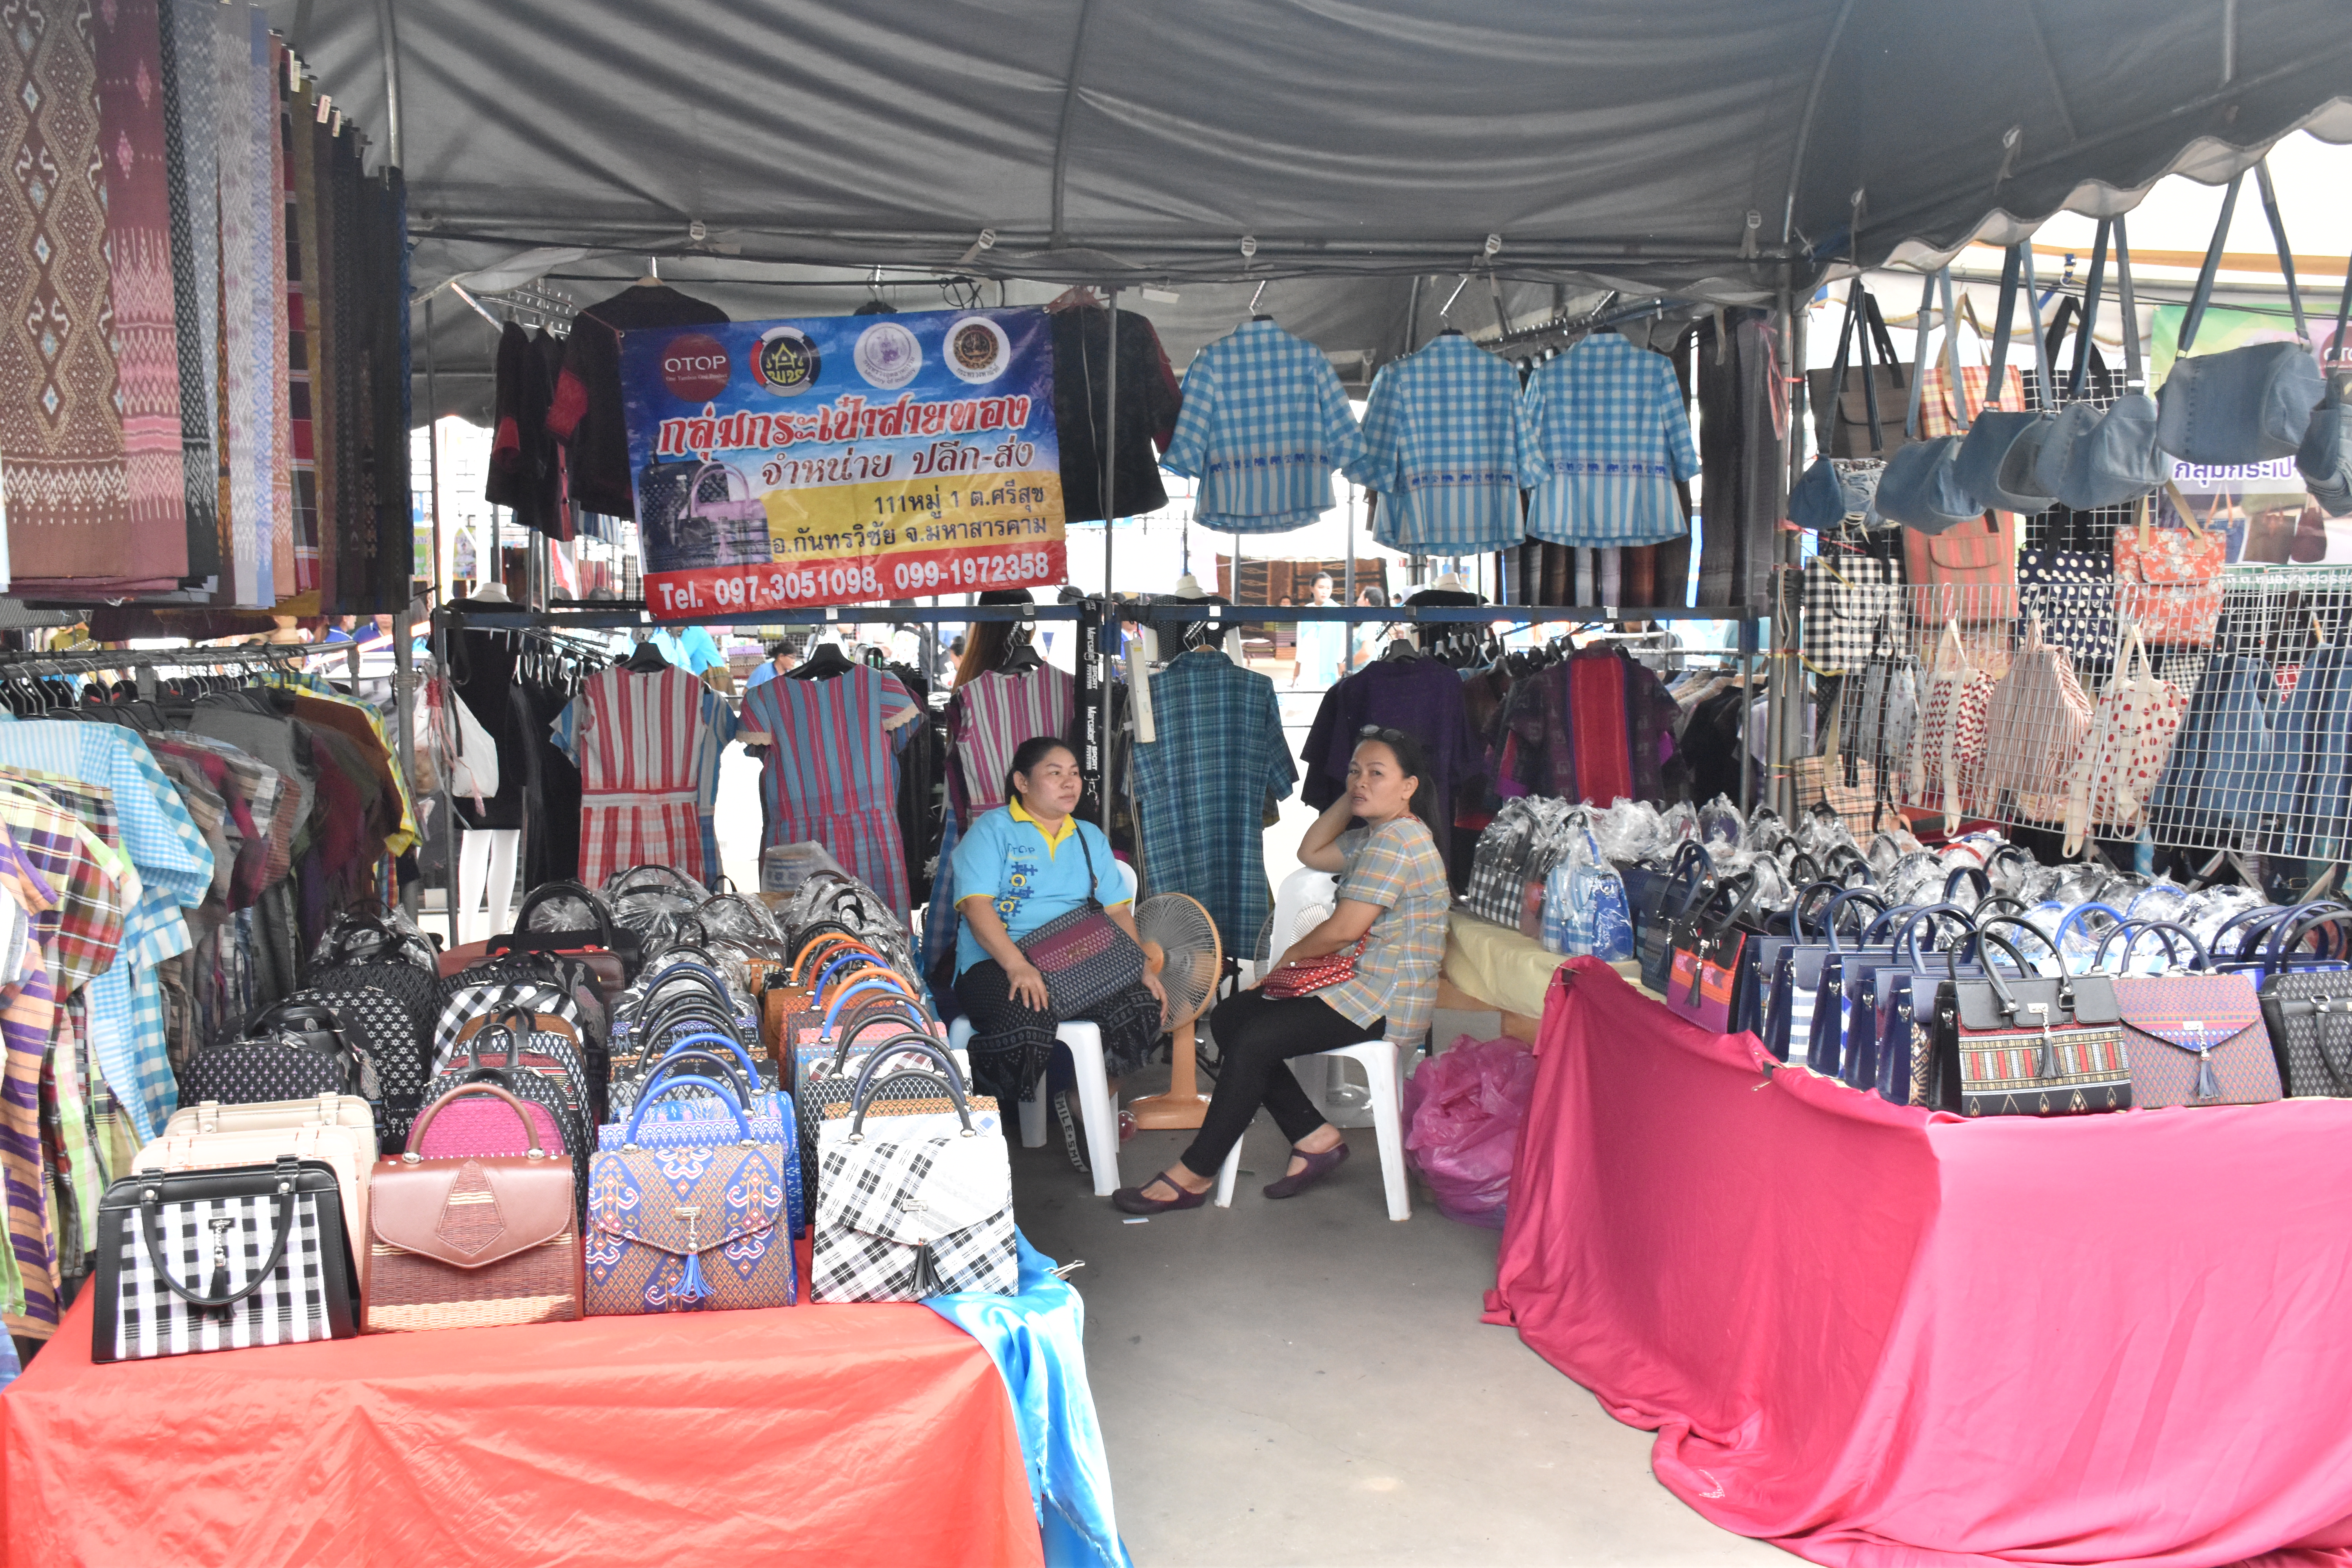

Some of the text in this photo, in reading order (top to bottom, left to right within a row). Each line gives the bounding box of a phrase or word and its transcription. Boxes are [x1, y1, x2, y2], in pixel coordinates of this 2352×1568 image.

[665, 356, 726, 372] OTOP
[659, 394, 1030, 462] กลุ่มกระเป๋าสายทอง
[762, 435, 1034, 486] จำหน่าย ปลีก-ส่ง
[950, 490, 959, 508] 1
[906, 517, 1047, 543] จ.มหาสารคาม
[659, 552, 1049, 610] Tel. 097-3051098, 099-1972358
